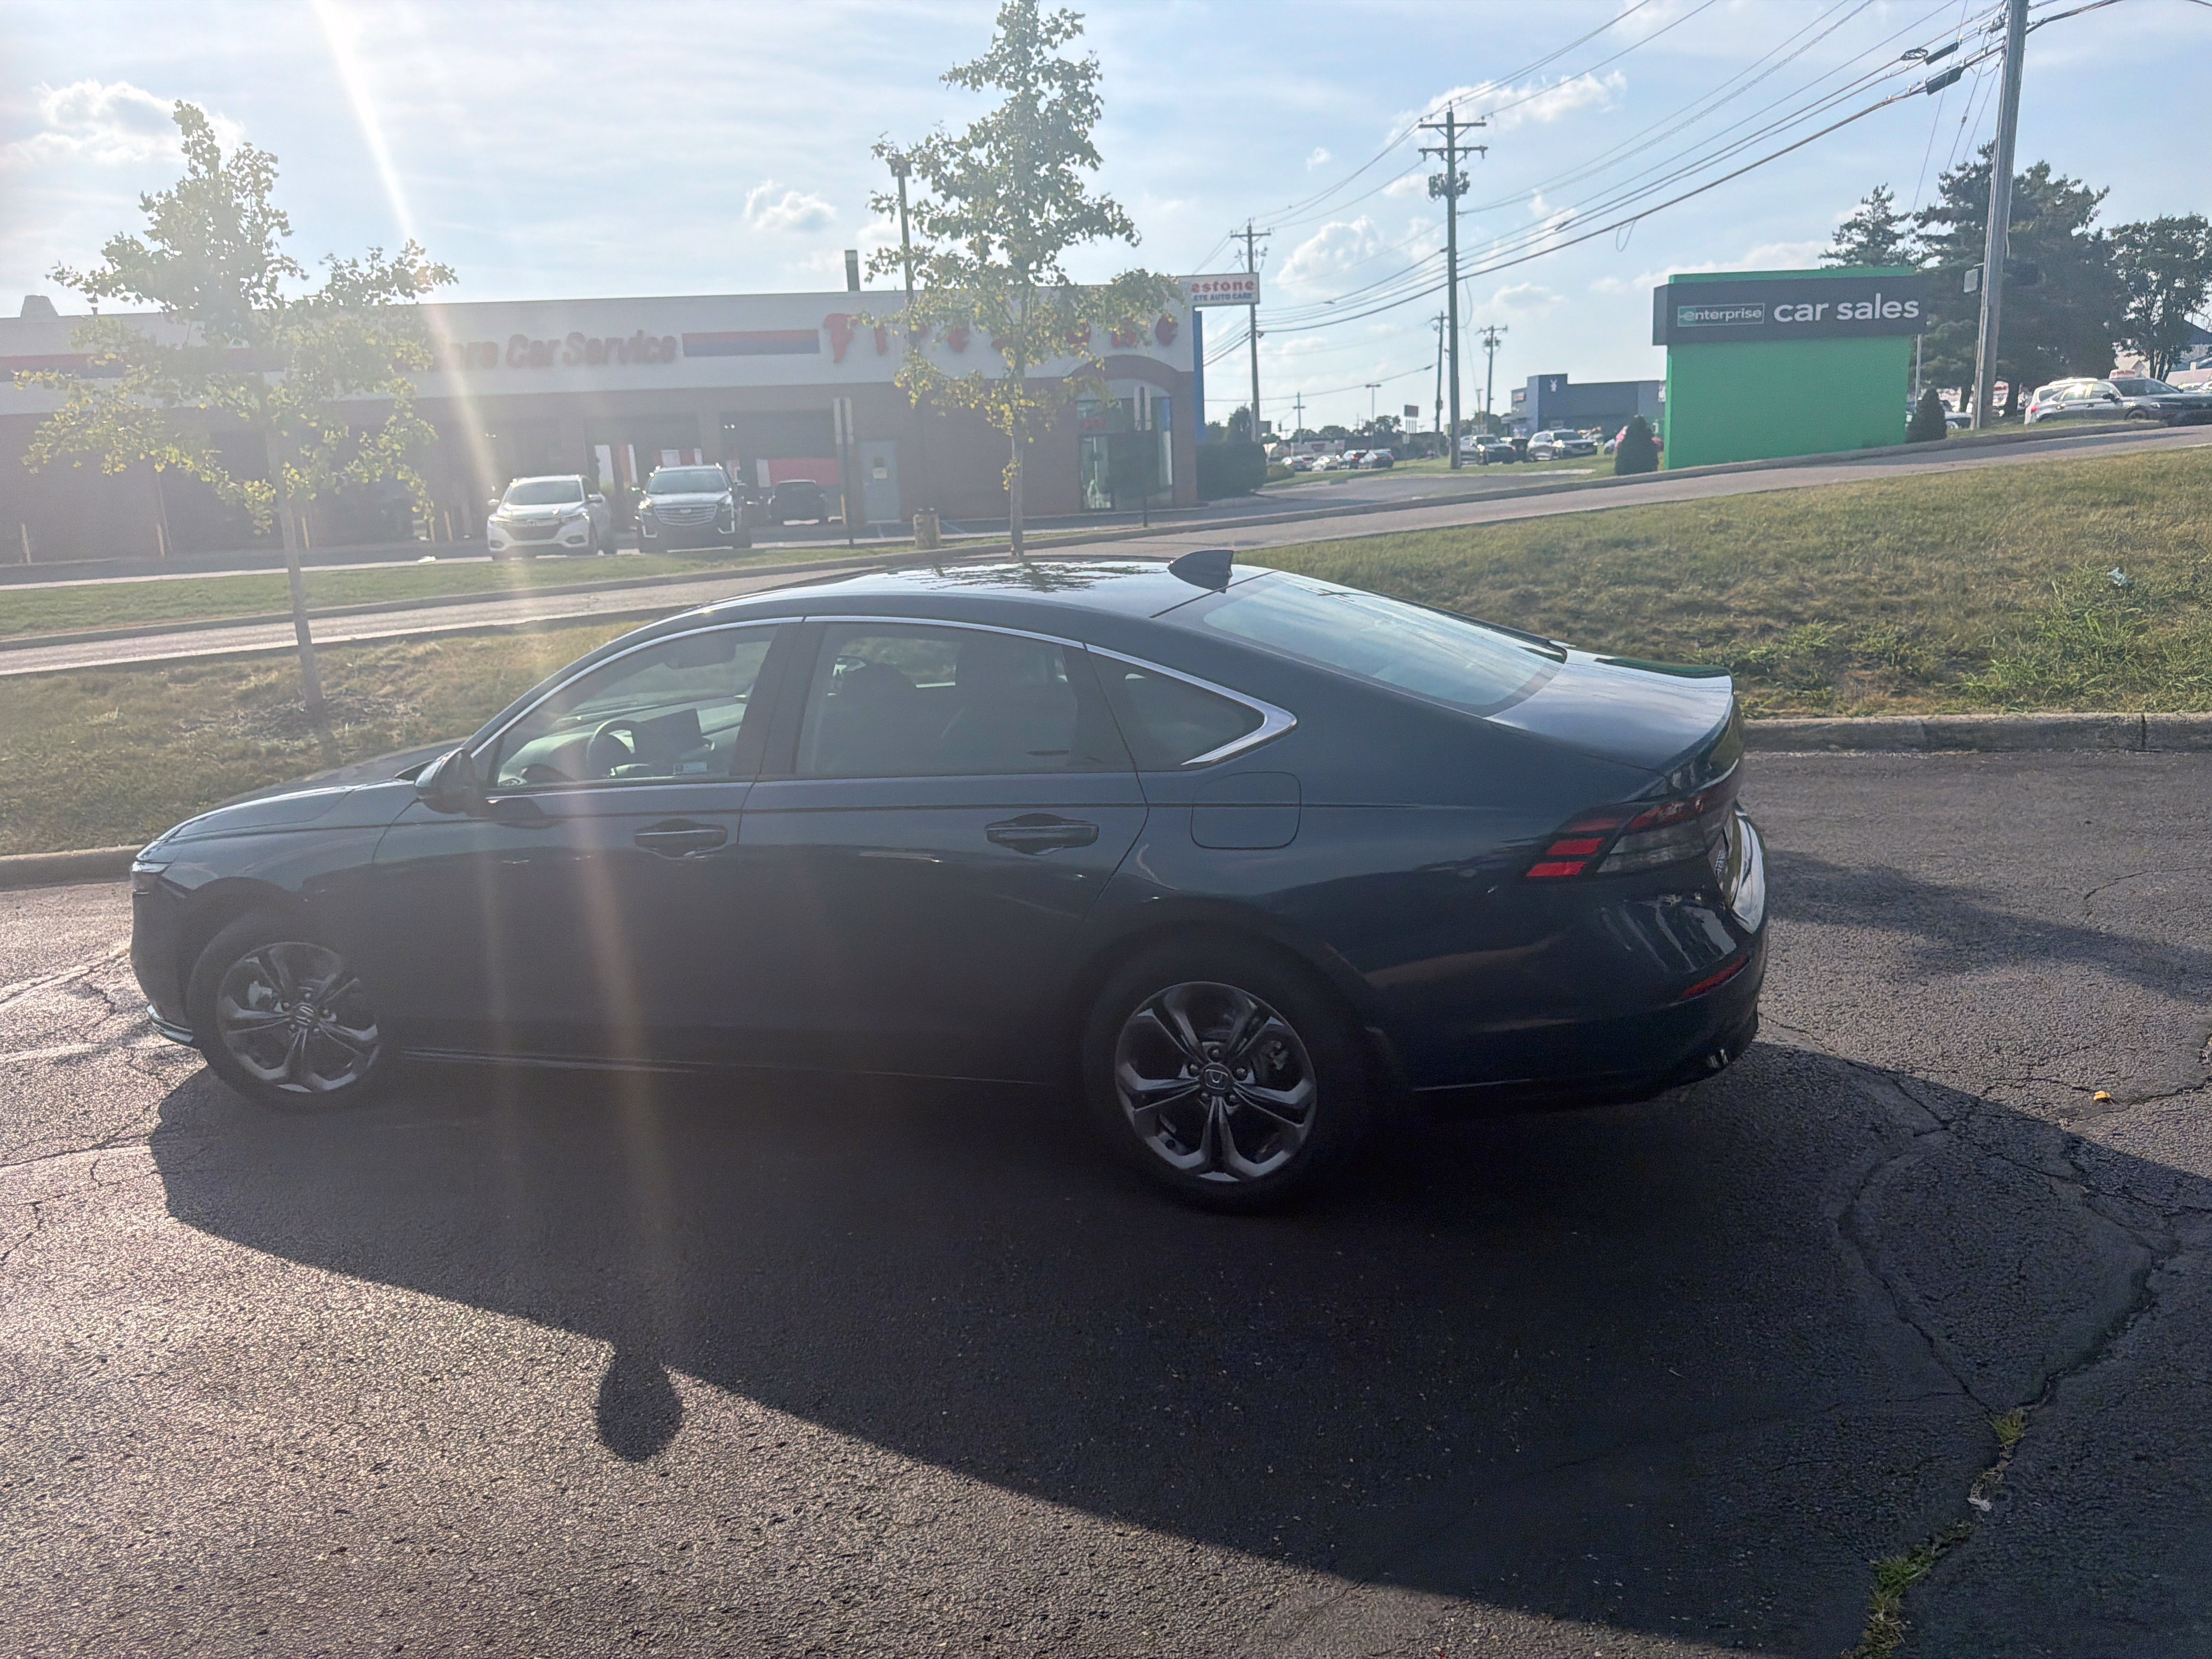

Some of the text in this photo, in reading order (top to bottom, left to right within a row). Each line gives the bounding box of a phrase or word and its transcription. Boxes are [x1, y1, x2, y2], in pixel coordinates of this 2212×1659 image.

[1684, 292, 1920, 323] enterprise car sales
[506, 334, 562, 368] Car
[562, 330, 678, 366] Service
